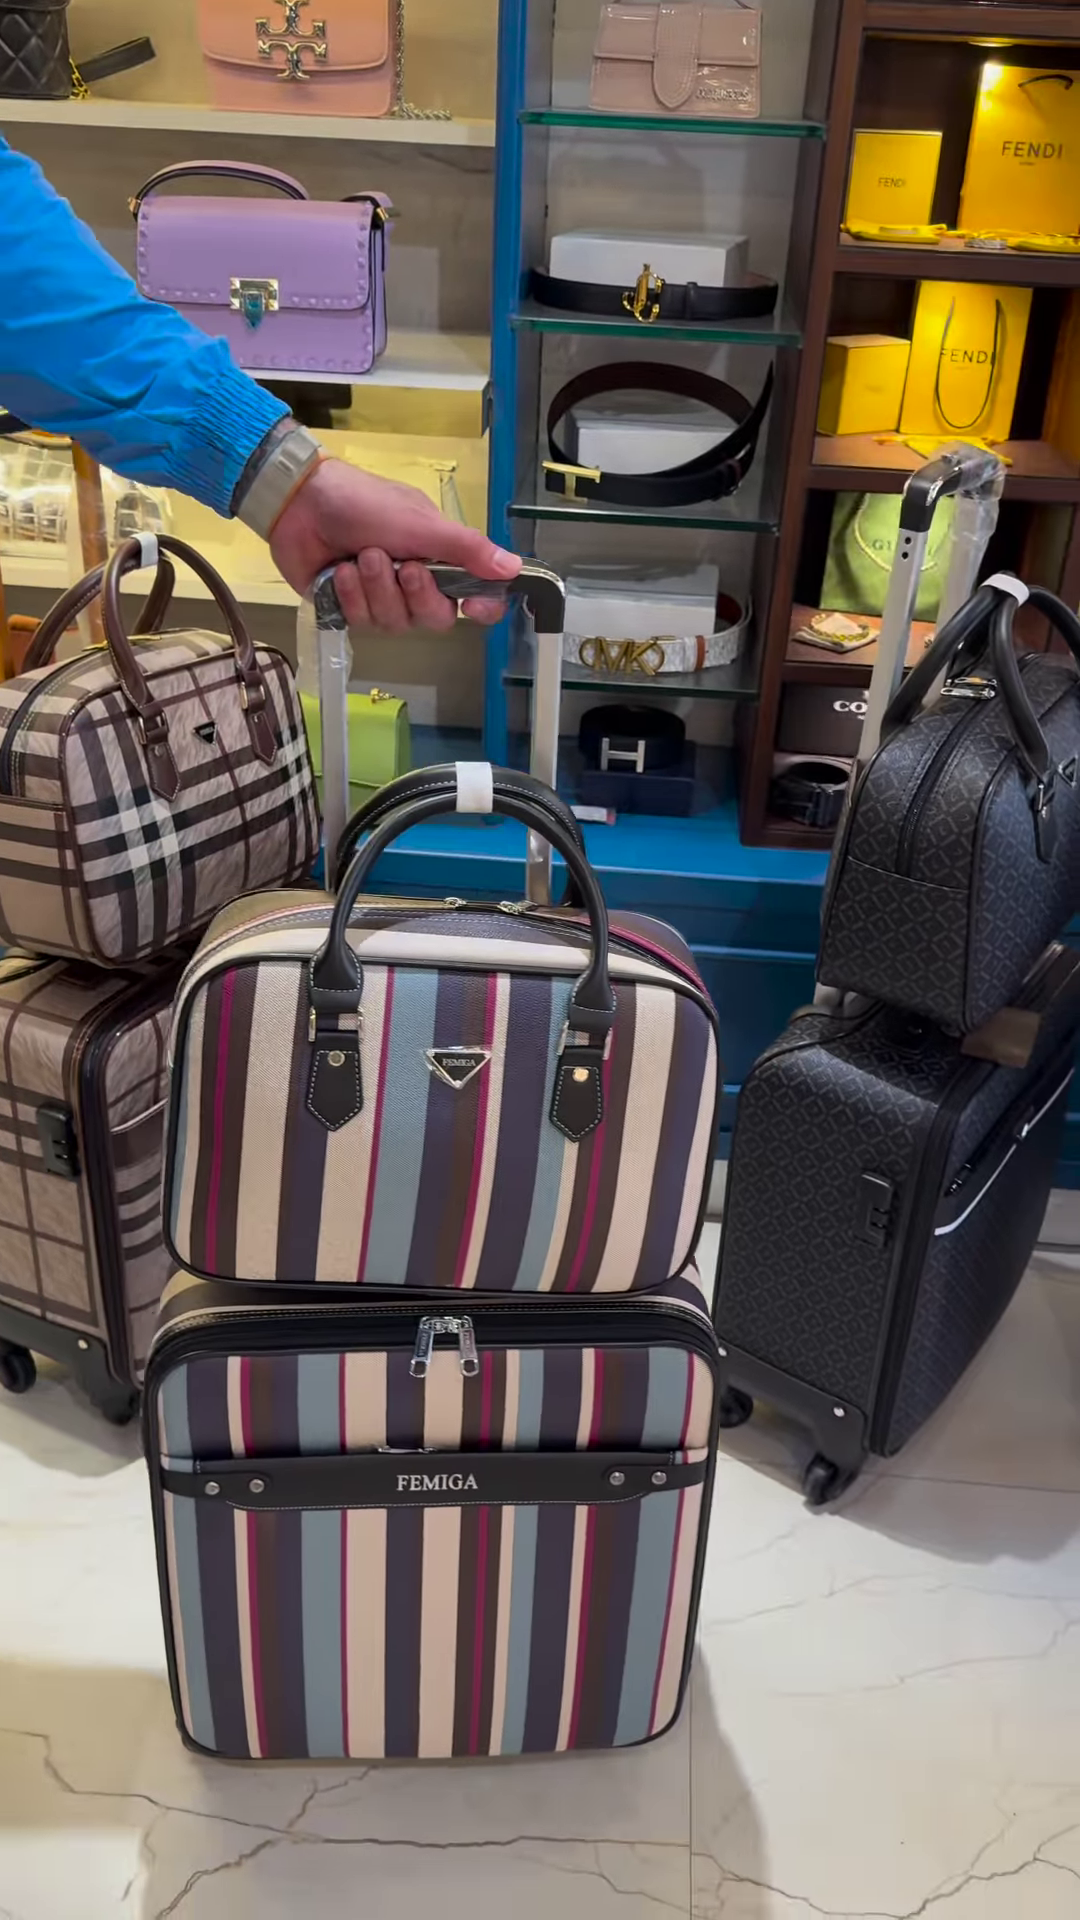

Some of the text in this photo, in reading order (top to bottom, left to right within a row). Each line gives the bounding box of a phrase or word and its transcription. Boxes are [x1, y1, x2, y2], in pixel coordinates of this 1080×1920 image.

[1001, 140, 1063, 159] FENDI
[441, 1058, 477, 1067] FEMIGA
[396, 1473, 479, 1491] FEMIGA
